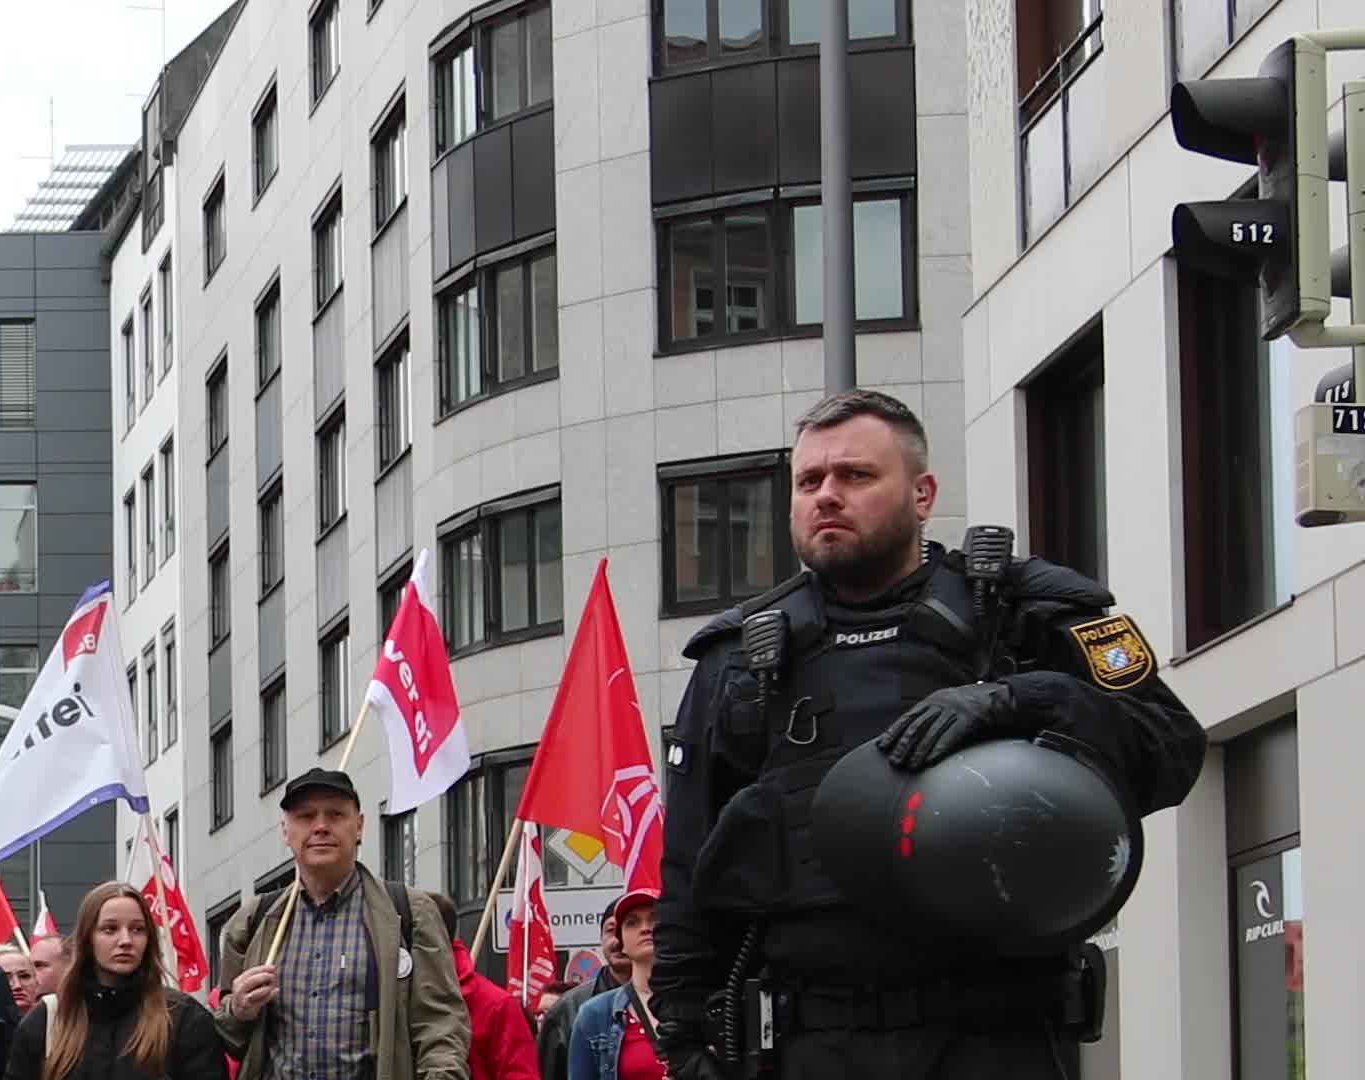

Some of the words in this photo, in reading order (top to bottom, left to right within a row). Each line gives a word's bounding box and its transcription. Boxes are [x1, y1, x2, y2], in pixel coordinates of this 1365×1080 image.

[1232, 223, 1273, 243] 512
[1334, 409, 1365, 431] 71
[836, 626, 898, 644] POLIZEI
[1080, 621, 1128, 642] POLIZEI
